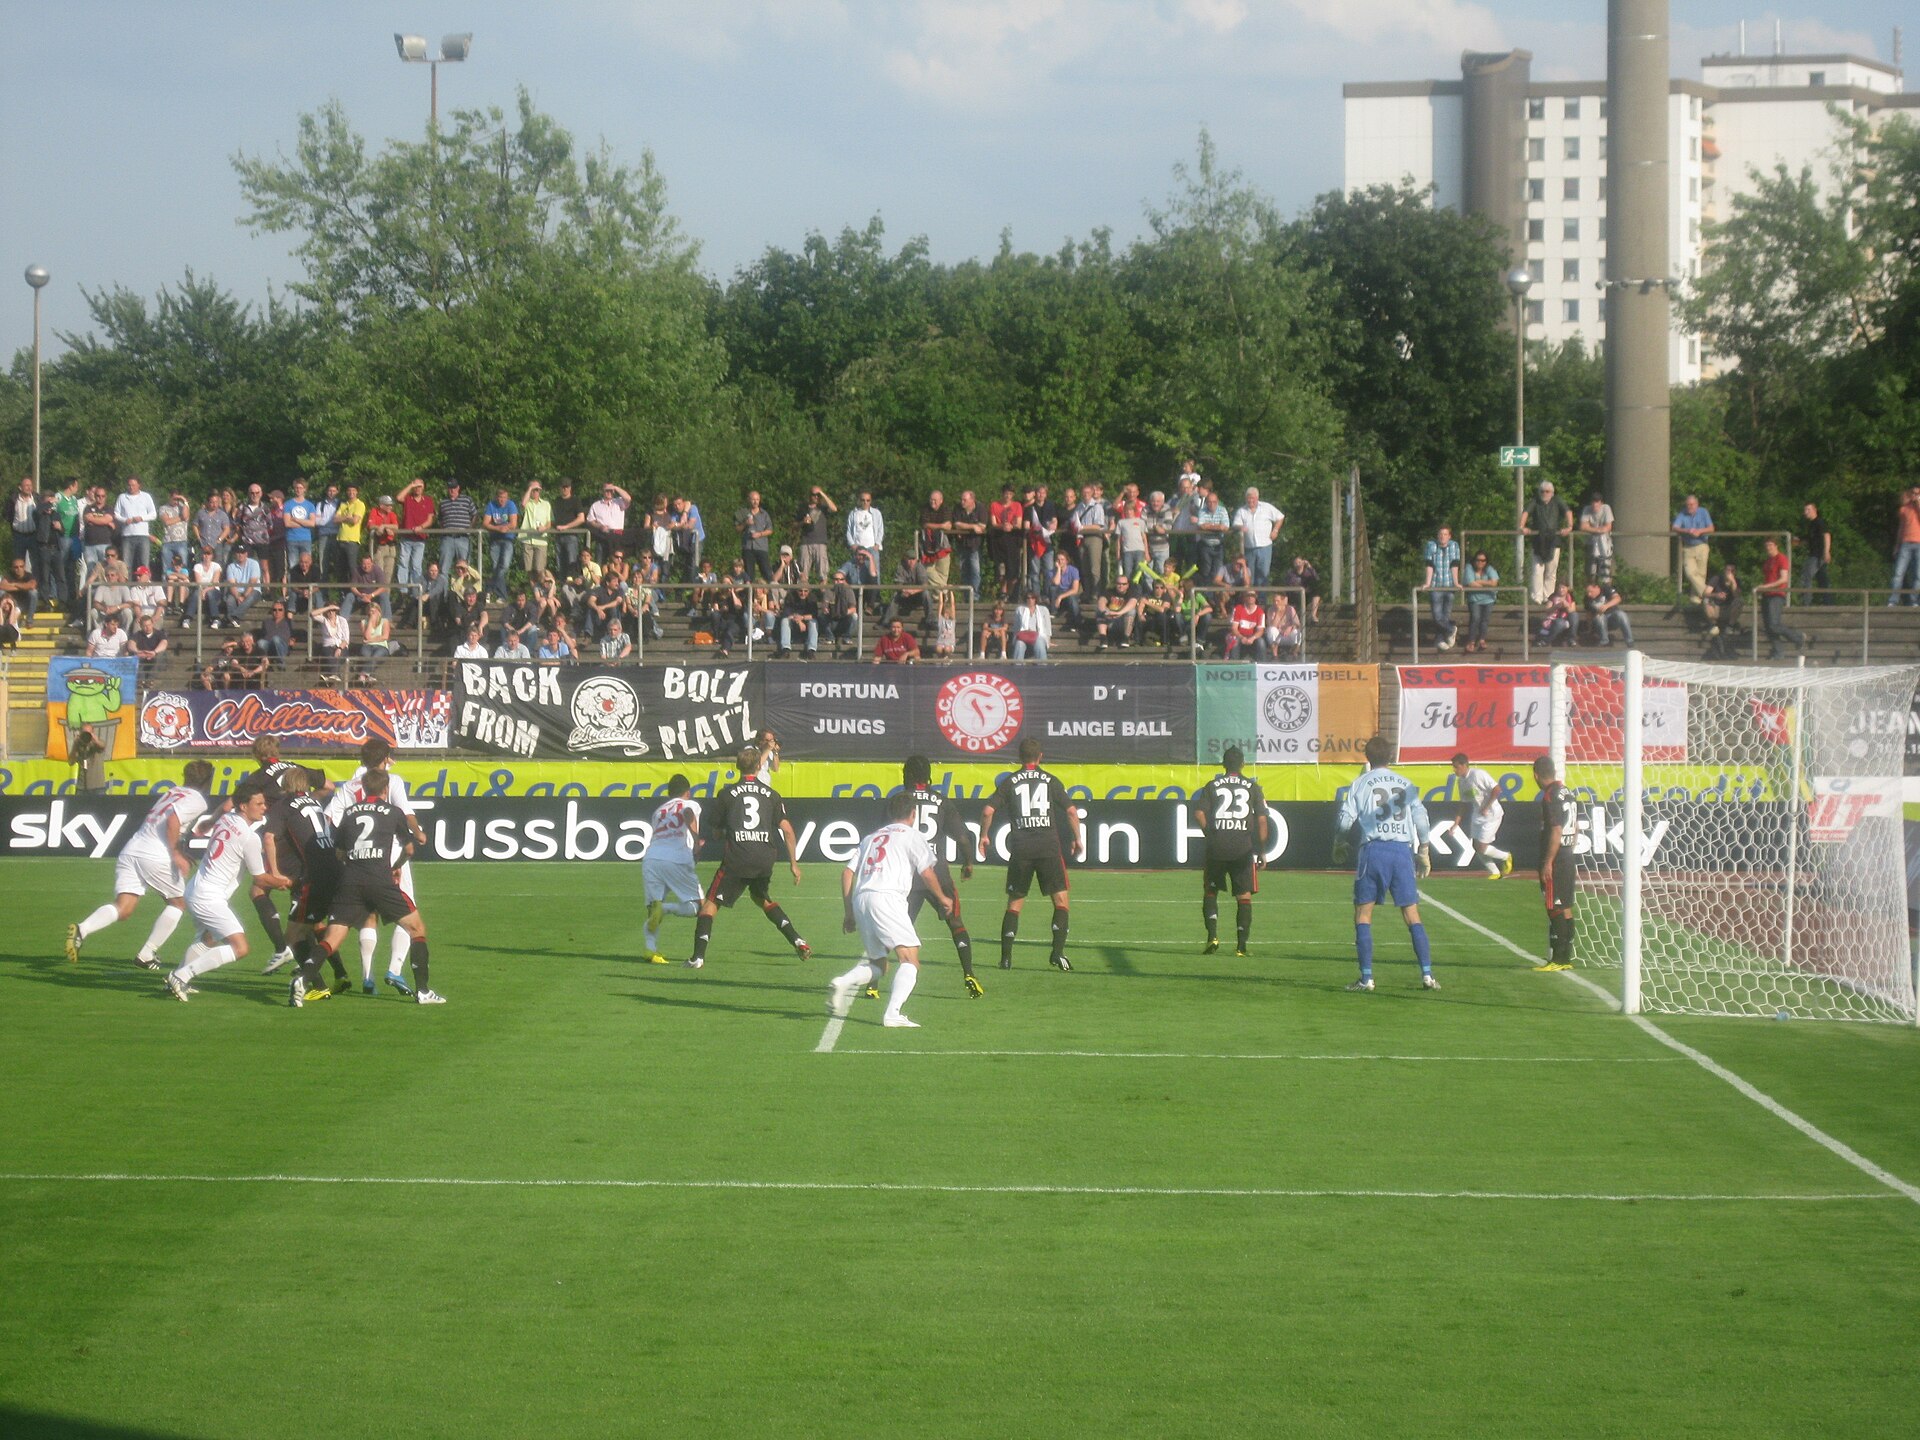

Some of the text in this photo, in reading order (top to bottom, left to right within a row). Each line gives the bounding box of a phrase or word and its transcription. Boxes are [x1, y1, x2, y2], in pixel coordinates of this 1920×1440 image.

[461, 662, 563, 706] BACK
[663, 666, 749, 705] BOLZ
[800, 682, 900, 699] FORTUNA
[1205, 670, 1368, 682] NOEL CAMPBELL
[1404, 668, 1466, 685] S.C.
[946, 674, 1021, 728] FORTUNA
[460, 700, 541, 759] FROM
[657, 700, 758, 760] PLATZ
[813, 718, 886, 735] JUNGS
[1047, 721, 1173, 737] LANGE BALL
[1420, 702, 1498, 730] Field
[1506, 701, 1540, 737] of
[1207, 734, 1368, 754] SCHÄNG GÄNG
[730, 784, 772, 798] BAYER 04
[1011, 771, 1052, 784] BAYER 04
[1214, 777, 1252, 788] BAYER 04
[1367, 776, 1408, 787] BAYER 04
[346, 804, 391, 816] BAYER 04
[743, 795, 760, 830] 3
[930, 795, 942, 806] 04
[1014, 782, 1051, 817] 14
[1215, 787, 1250, 819] 23
[1372, 786, 1407, 821] 33
[9, 799, 128, 859] sky
[354, 815, 375, 850] 2
[407, 800, 655, 862] ussba
[1215, 819, 1248, 831] VIDAL
[867, 834, 890, 866] 3
